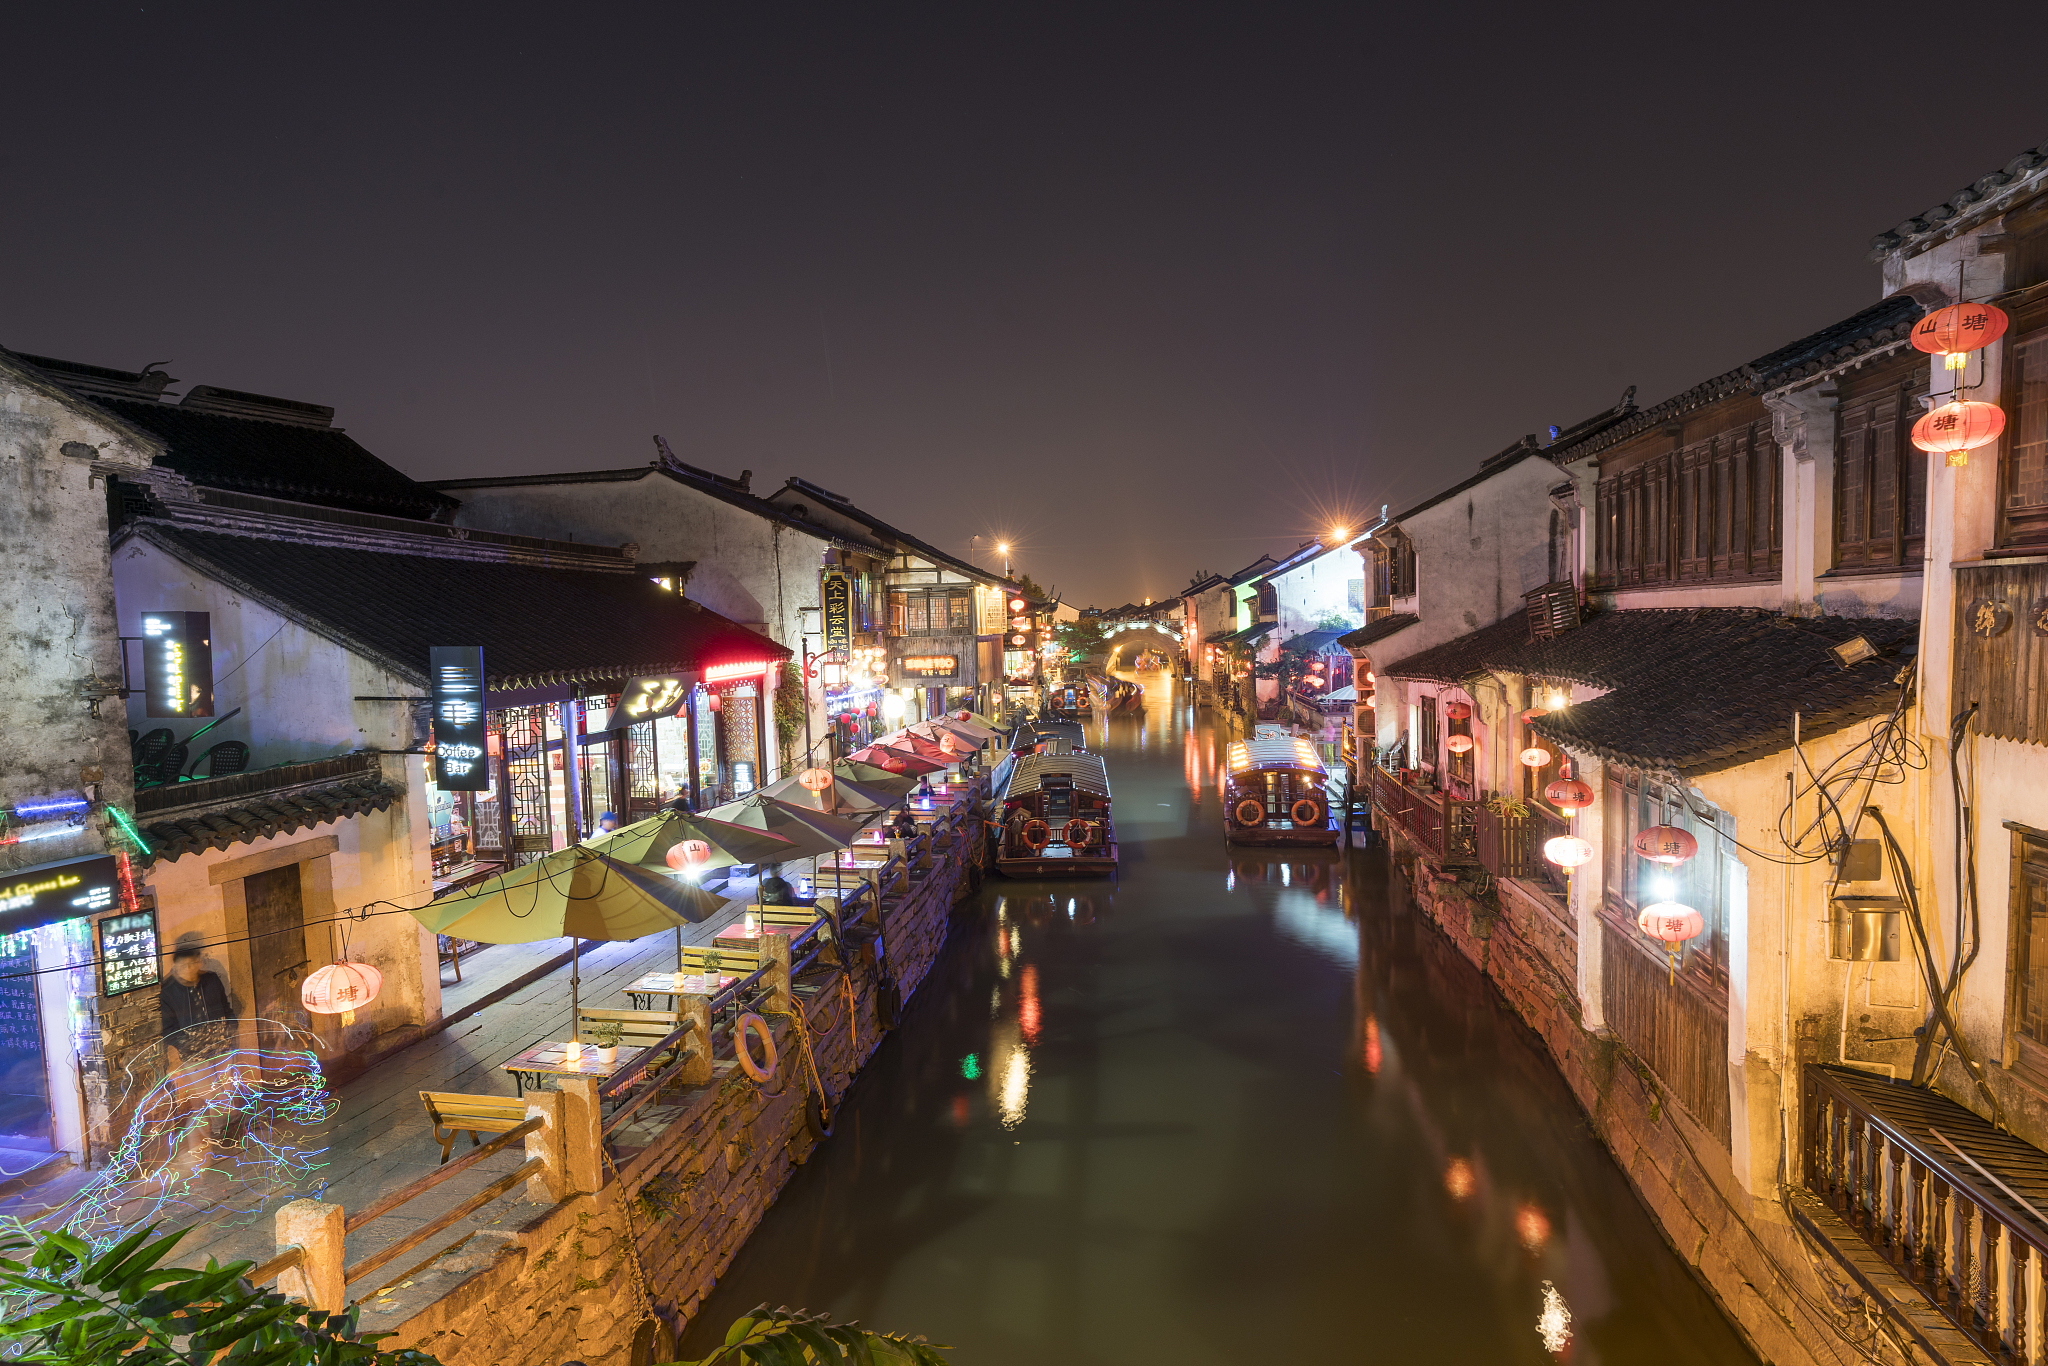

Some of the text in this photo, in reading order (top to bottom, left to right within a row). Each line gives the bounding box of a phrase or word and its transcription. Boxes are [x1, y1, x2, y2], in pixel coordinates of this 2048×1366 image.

[1933, 414, 1959, 431] 塘
[828, 581, 846, 638] 天上彩云堂
[437, 746, 475, 758] Coffee
[445, 763, 468, 773] Bar
